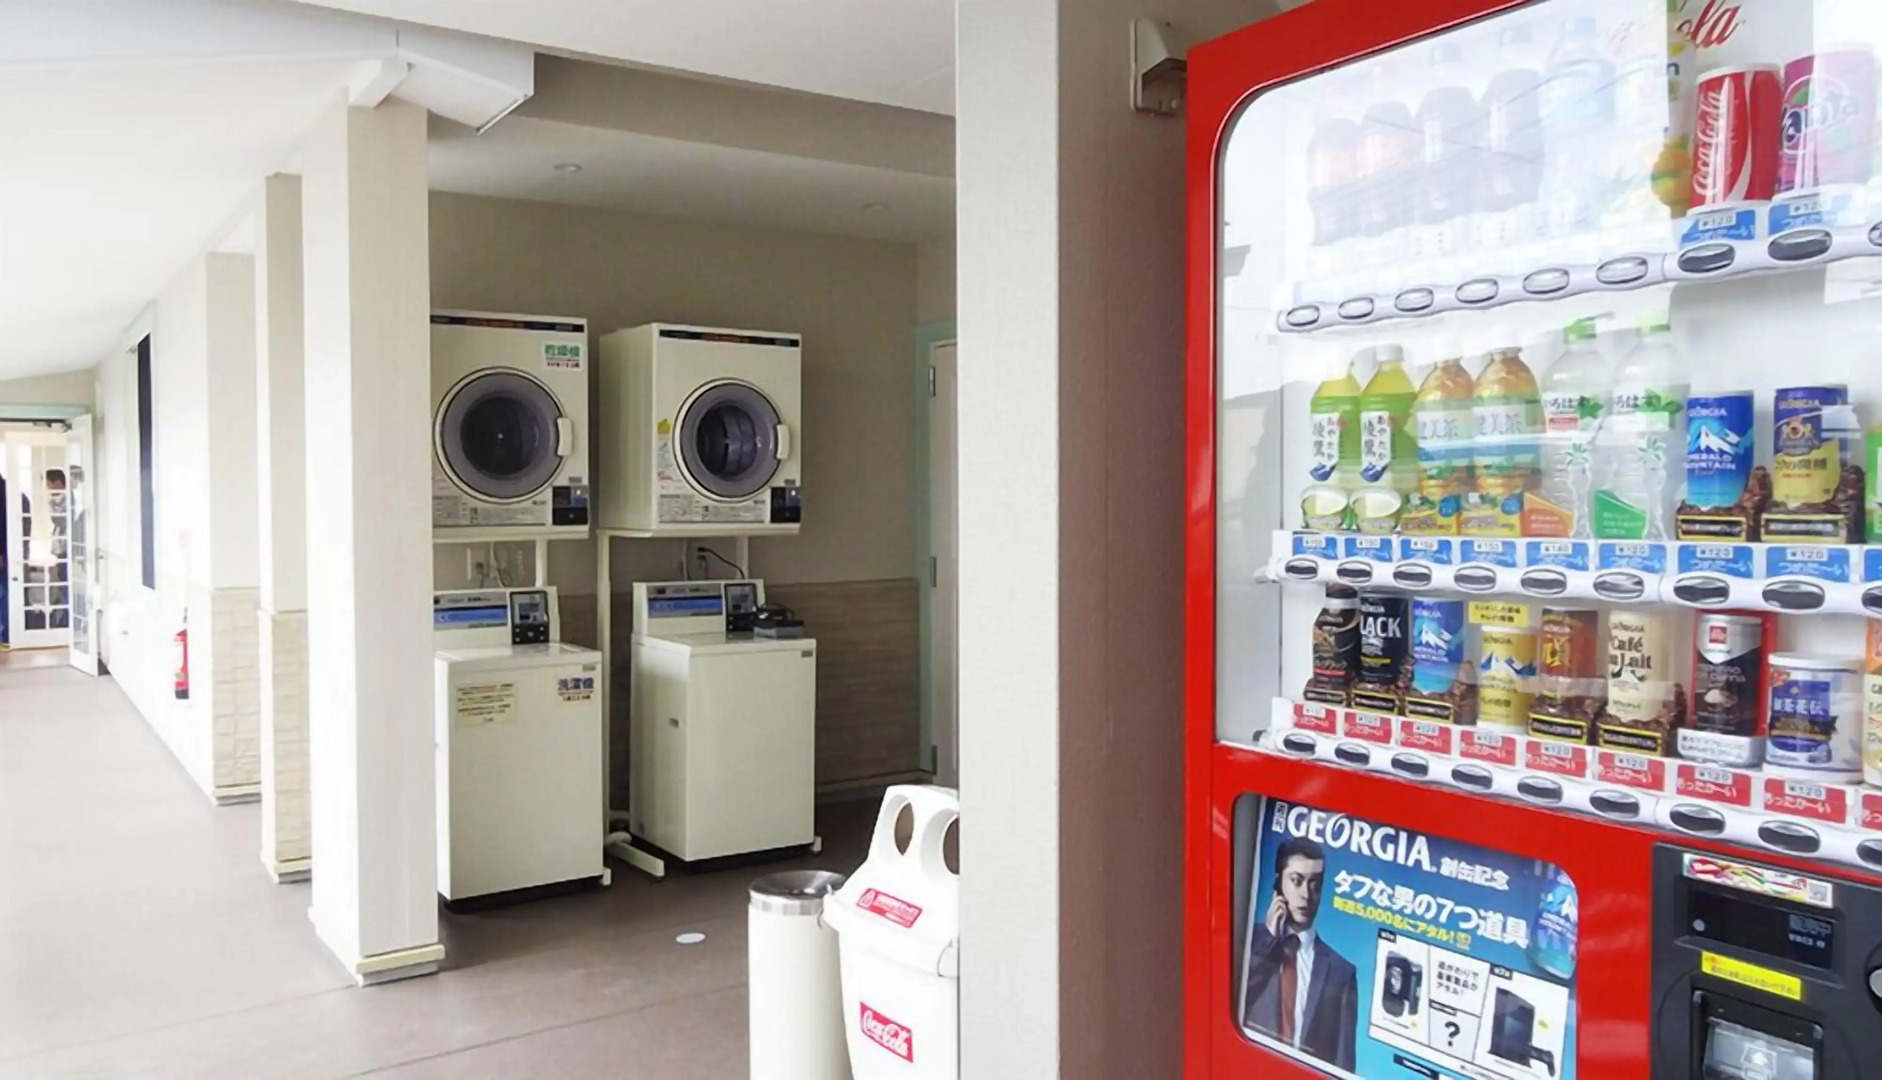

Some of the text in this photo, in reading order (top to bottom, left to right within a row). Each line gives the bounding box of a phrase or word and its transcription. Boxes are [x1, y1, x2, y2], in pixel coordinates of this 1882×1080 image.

[1333, 869, 1530, 949] タフな男の7つ道具
